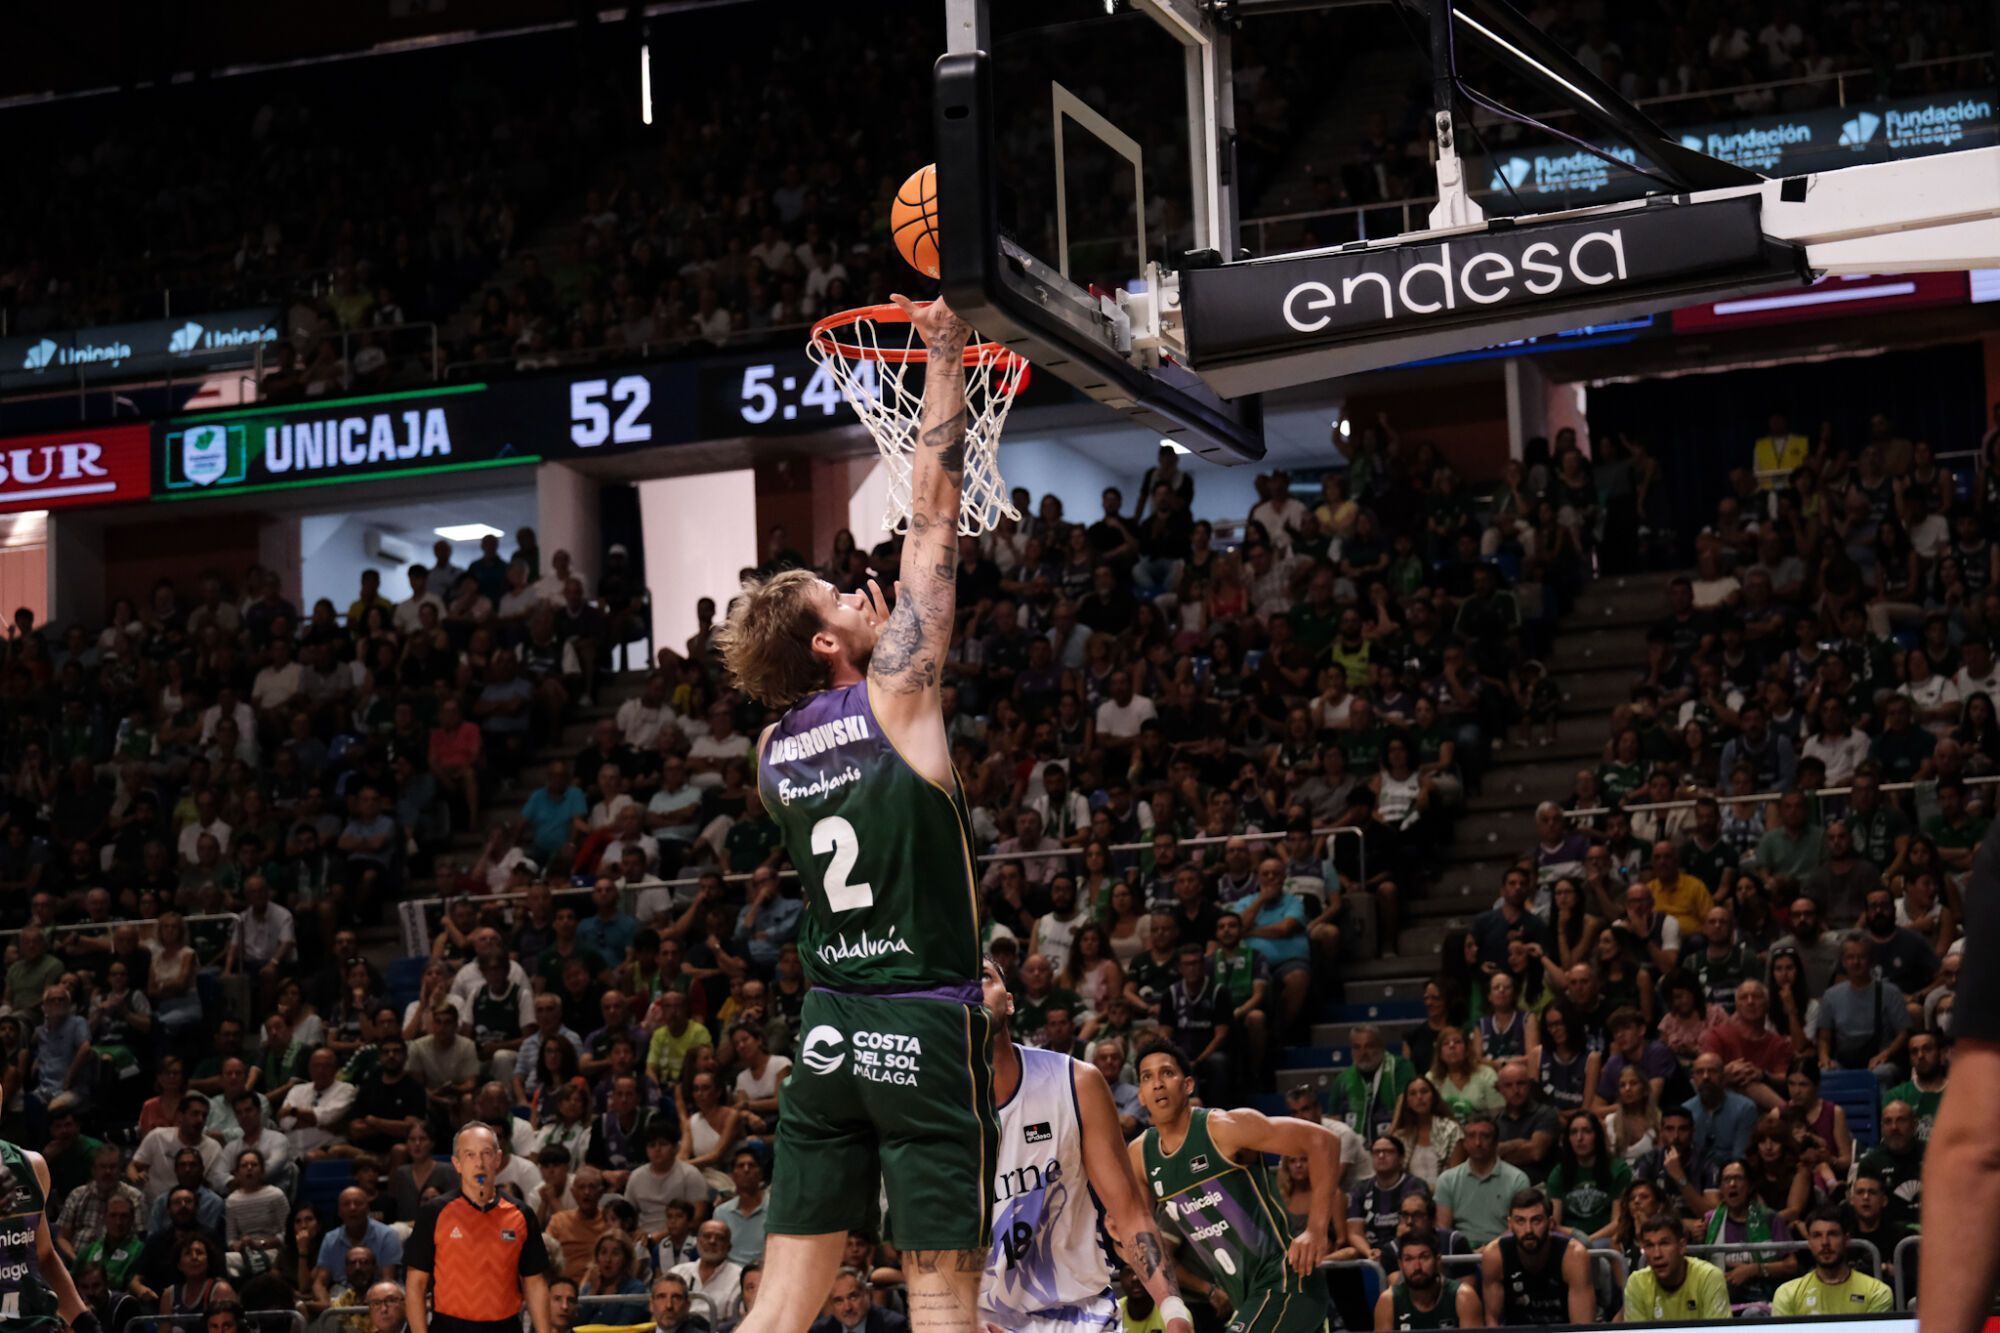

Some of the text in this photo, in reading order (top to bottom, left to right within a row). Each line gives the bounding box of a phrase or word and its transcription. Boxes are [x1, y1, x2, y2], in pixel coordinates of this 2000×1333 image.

[1885, 101, 1991, 128] Fundación
[1706, 123, 1812, 153] Fundación
[1282, 229, 1628, 333] endesa
[570, 374, 652, 448] 52
[264, 407, 452, 474] UNICAJA
[810, 815, 874, 914] 2
[852, 1030, 922, 1055] COSTA
[853, 1048, 920, 1072] DEL SOL
[853, 1063, 918, 1088] MÁLAGA
[993, 1159, 1061, 1204] rne
[1179, 1191, 1224, 1215] Unicaja
